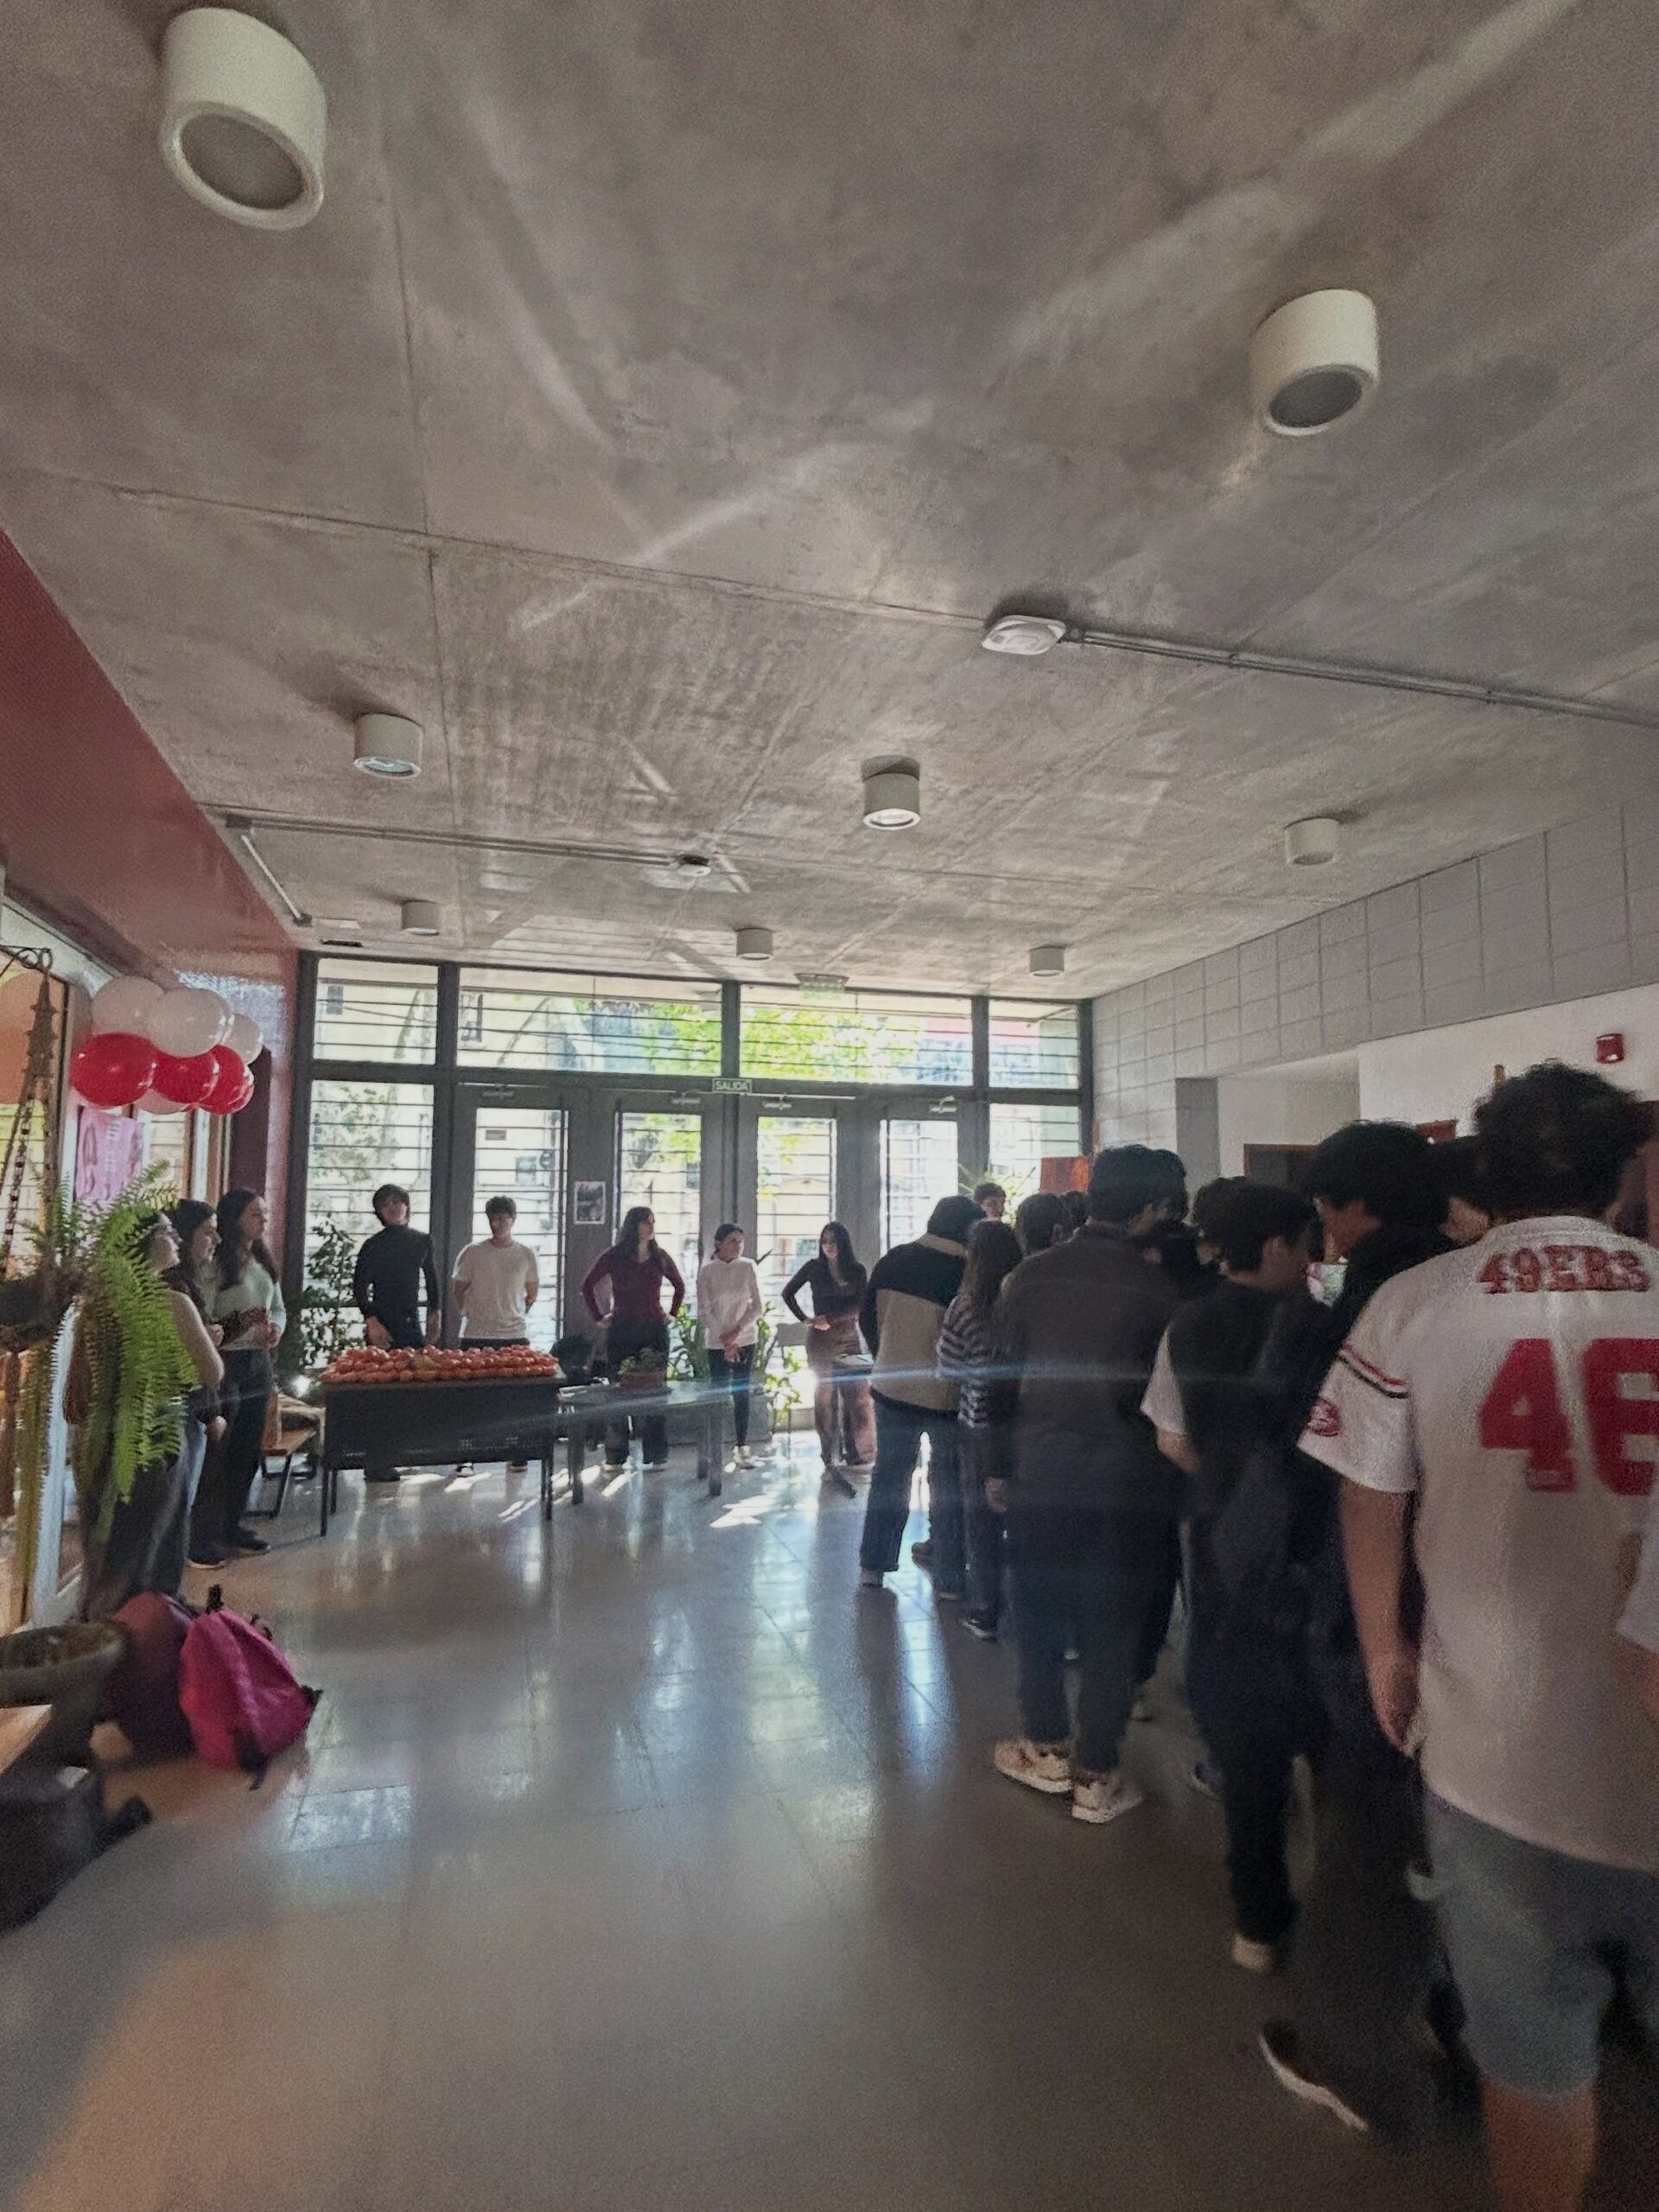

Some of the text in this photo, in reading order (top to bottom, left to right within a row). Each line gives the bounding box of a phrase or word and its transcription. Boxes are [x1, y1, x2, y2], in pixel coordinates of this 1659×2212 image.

[715, 1080, 749, 1091] SALIDA
[1478, 1245, 1652, 1294] 49ERS
[1478, 1338, 1659, 1496] 46
